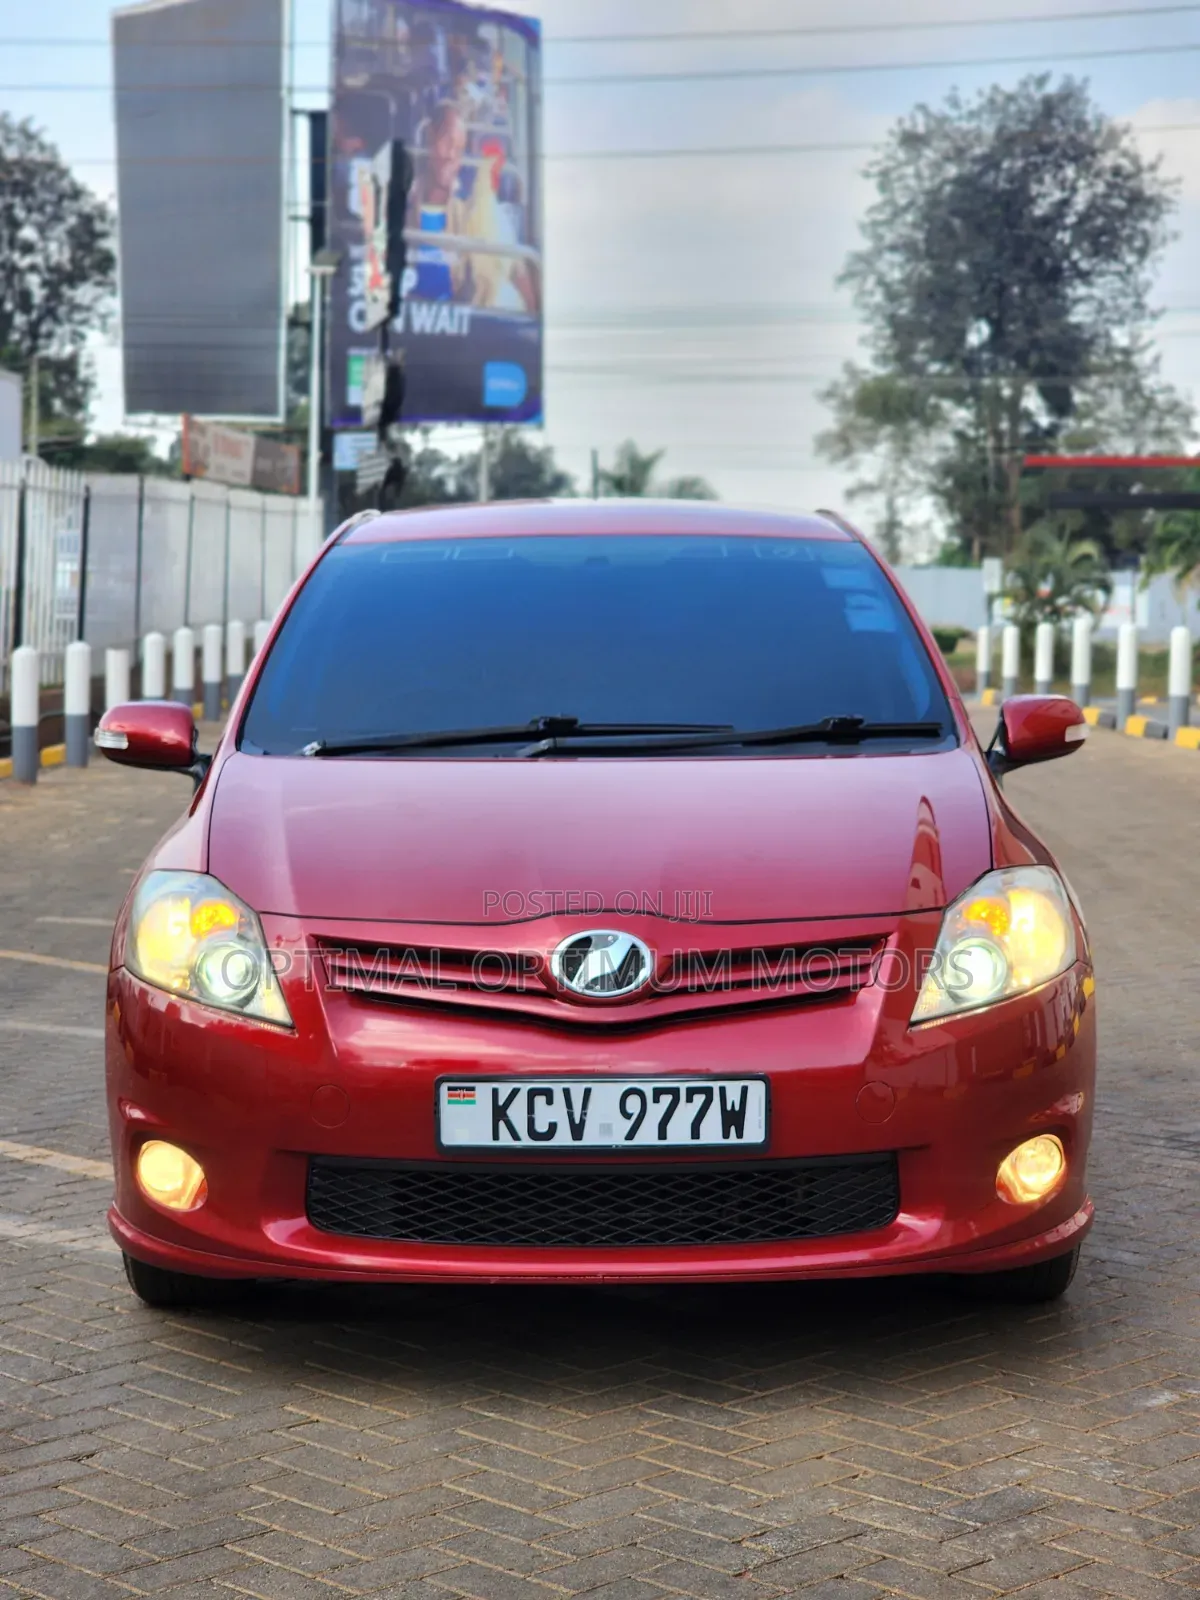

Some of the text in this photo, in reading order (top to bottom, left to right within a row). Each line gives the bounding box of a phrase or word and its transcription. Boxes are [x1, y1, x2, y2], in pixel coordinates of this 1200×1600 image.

[410, 302, 472, 336] WAIT
[491, 1086, 593, 1141] KCV
[618, 1085, 749, 1141] 977W
